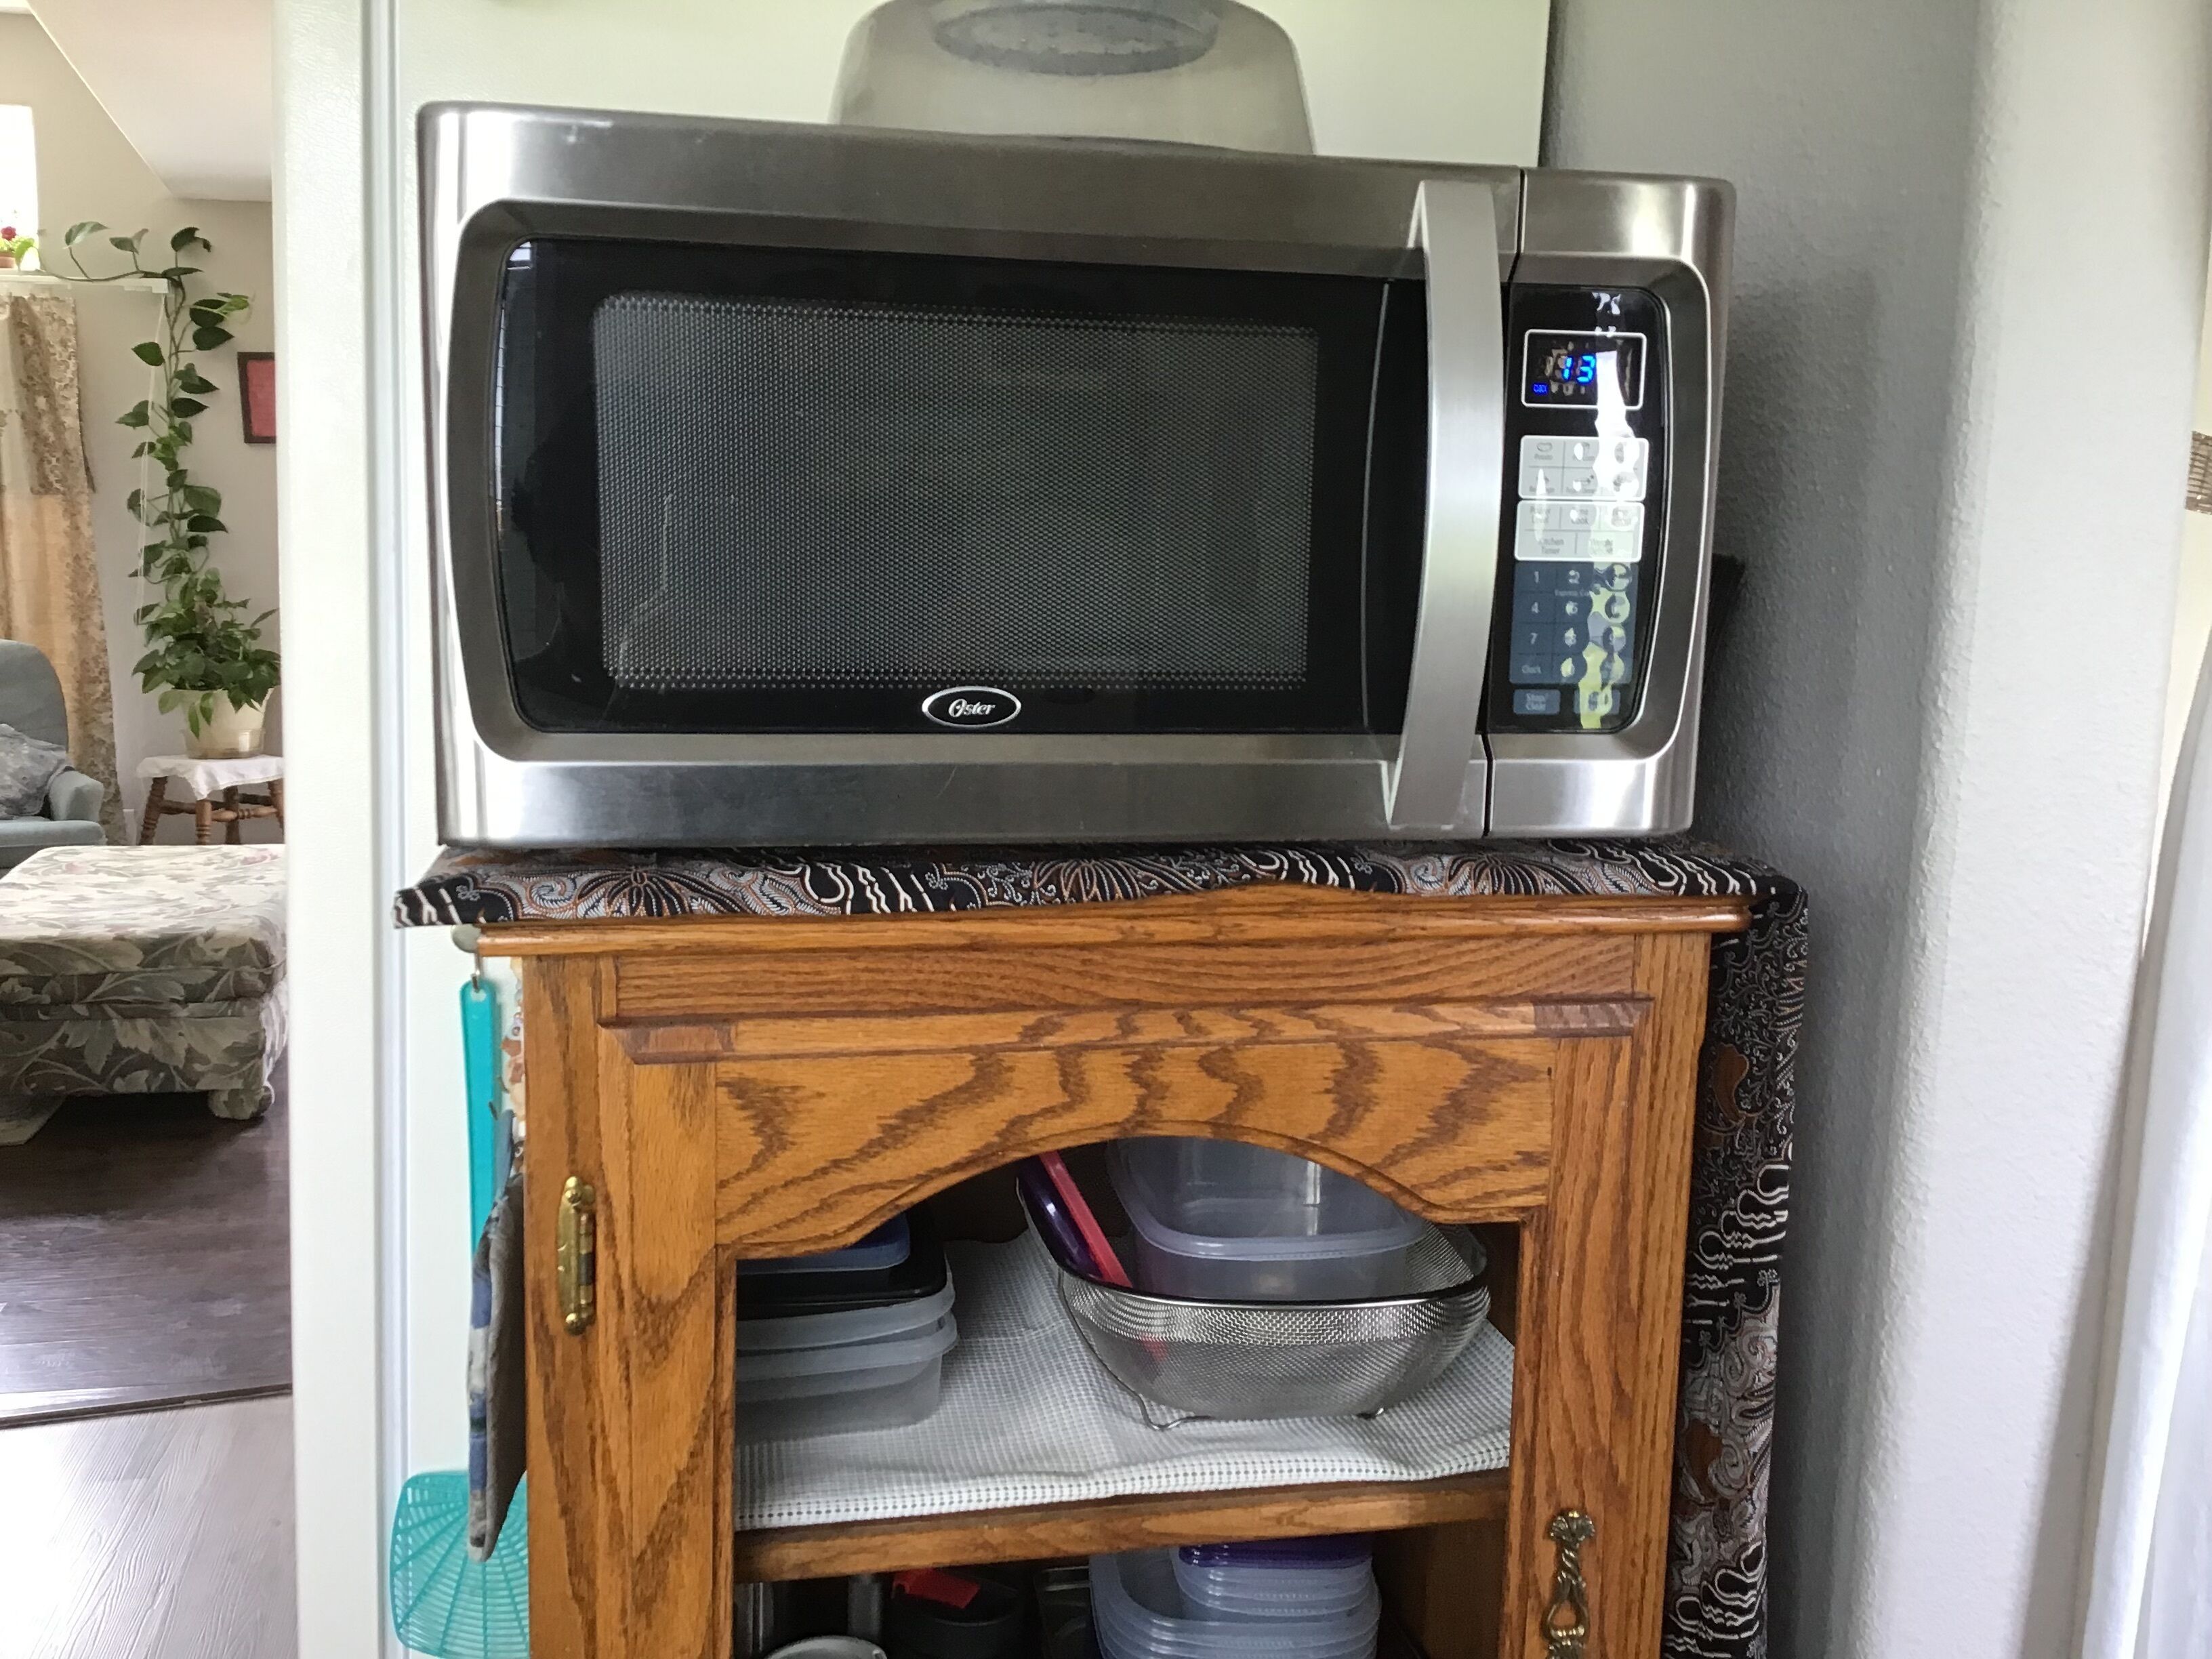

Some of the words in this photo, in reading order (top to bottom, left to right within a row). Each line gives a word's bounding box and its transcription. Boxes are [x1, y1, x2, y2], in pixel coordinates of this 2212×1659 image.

[1534, 571, 1540, 583] 1
[1531, 601, 1540, 614] 4
[1530, 633, 1539, 645] 7
[948, 698, 996, 718] Oster
